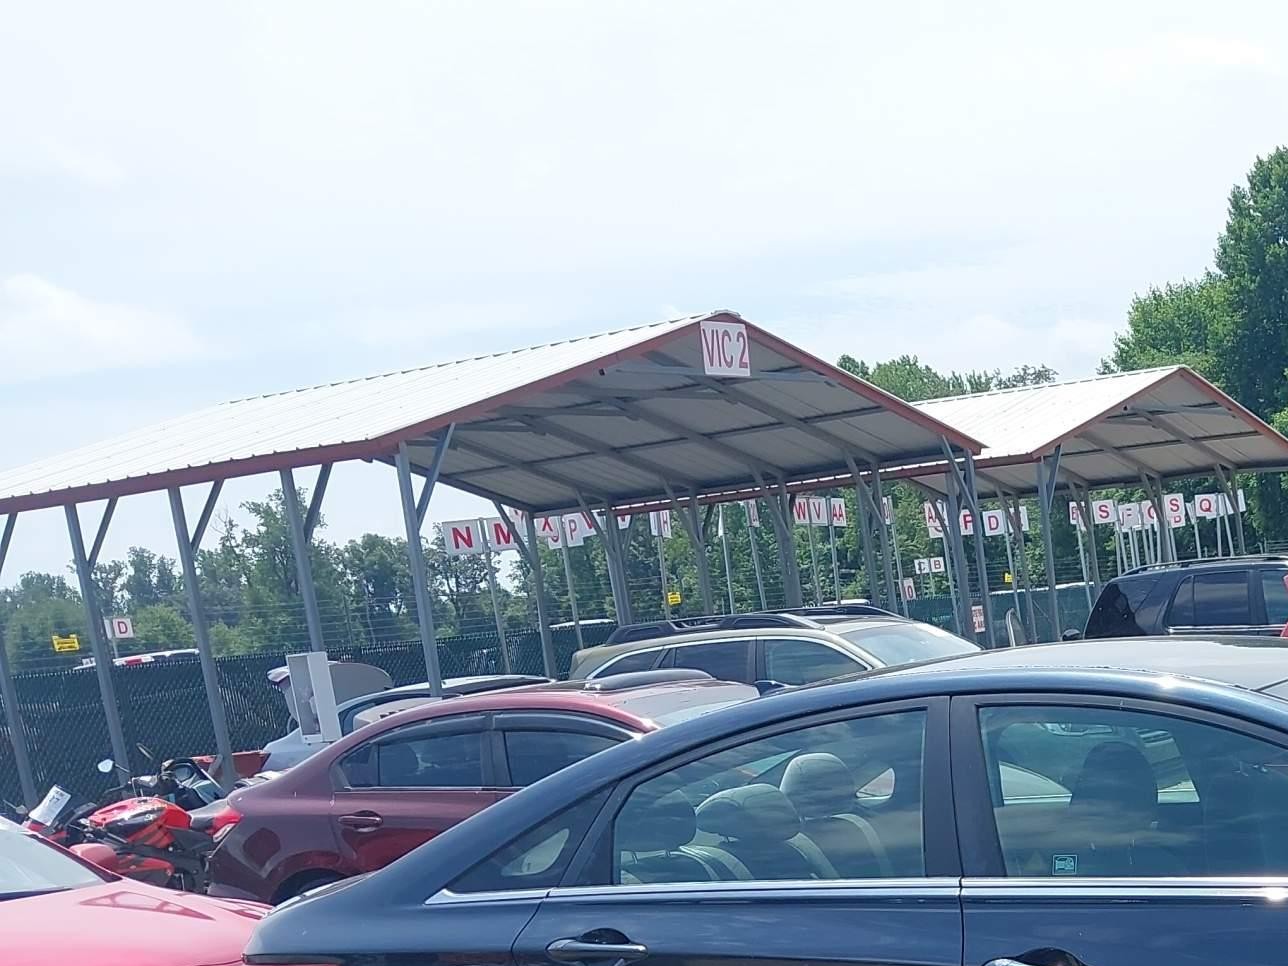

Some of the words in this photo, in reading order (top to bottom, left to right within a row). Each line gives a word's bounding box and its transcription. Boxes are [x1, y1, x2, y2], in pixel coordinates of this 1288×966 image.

[794, 502, 806, 520] W
[811, 502, 820, 520] V
[832, 503, 844, 522] AA
[1098, 504, 1110, 519] S
[1169, 498, 1180, 512] S
[1199, 498, 1212, 513] Q
[567, 519, 577, 541] P
[962, 514, 974, 530] F
[987, 515, 999, 531] D
[452, 526, 473, 549] N
[493, 523, 512, 545] M
[933, 559, 942, 570] B
[117, 621, 128, 634] D
